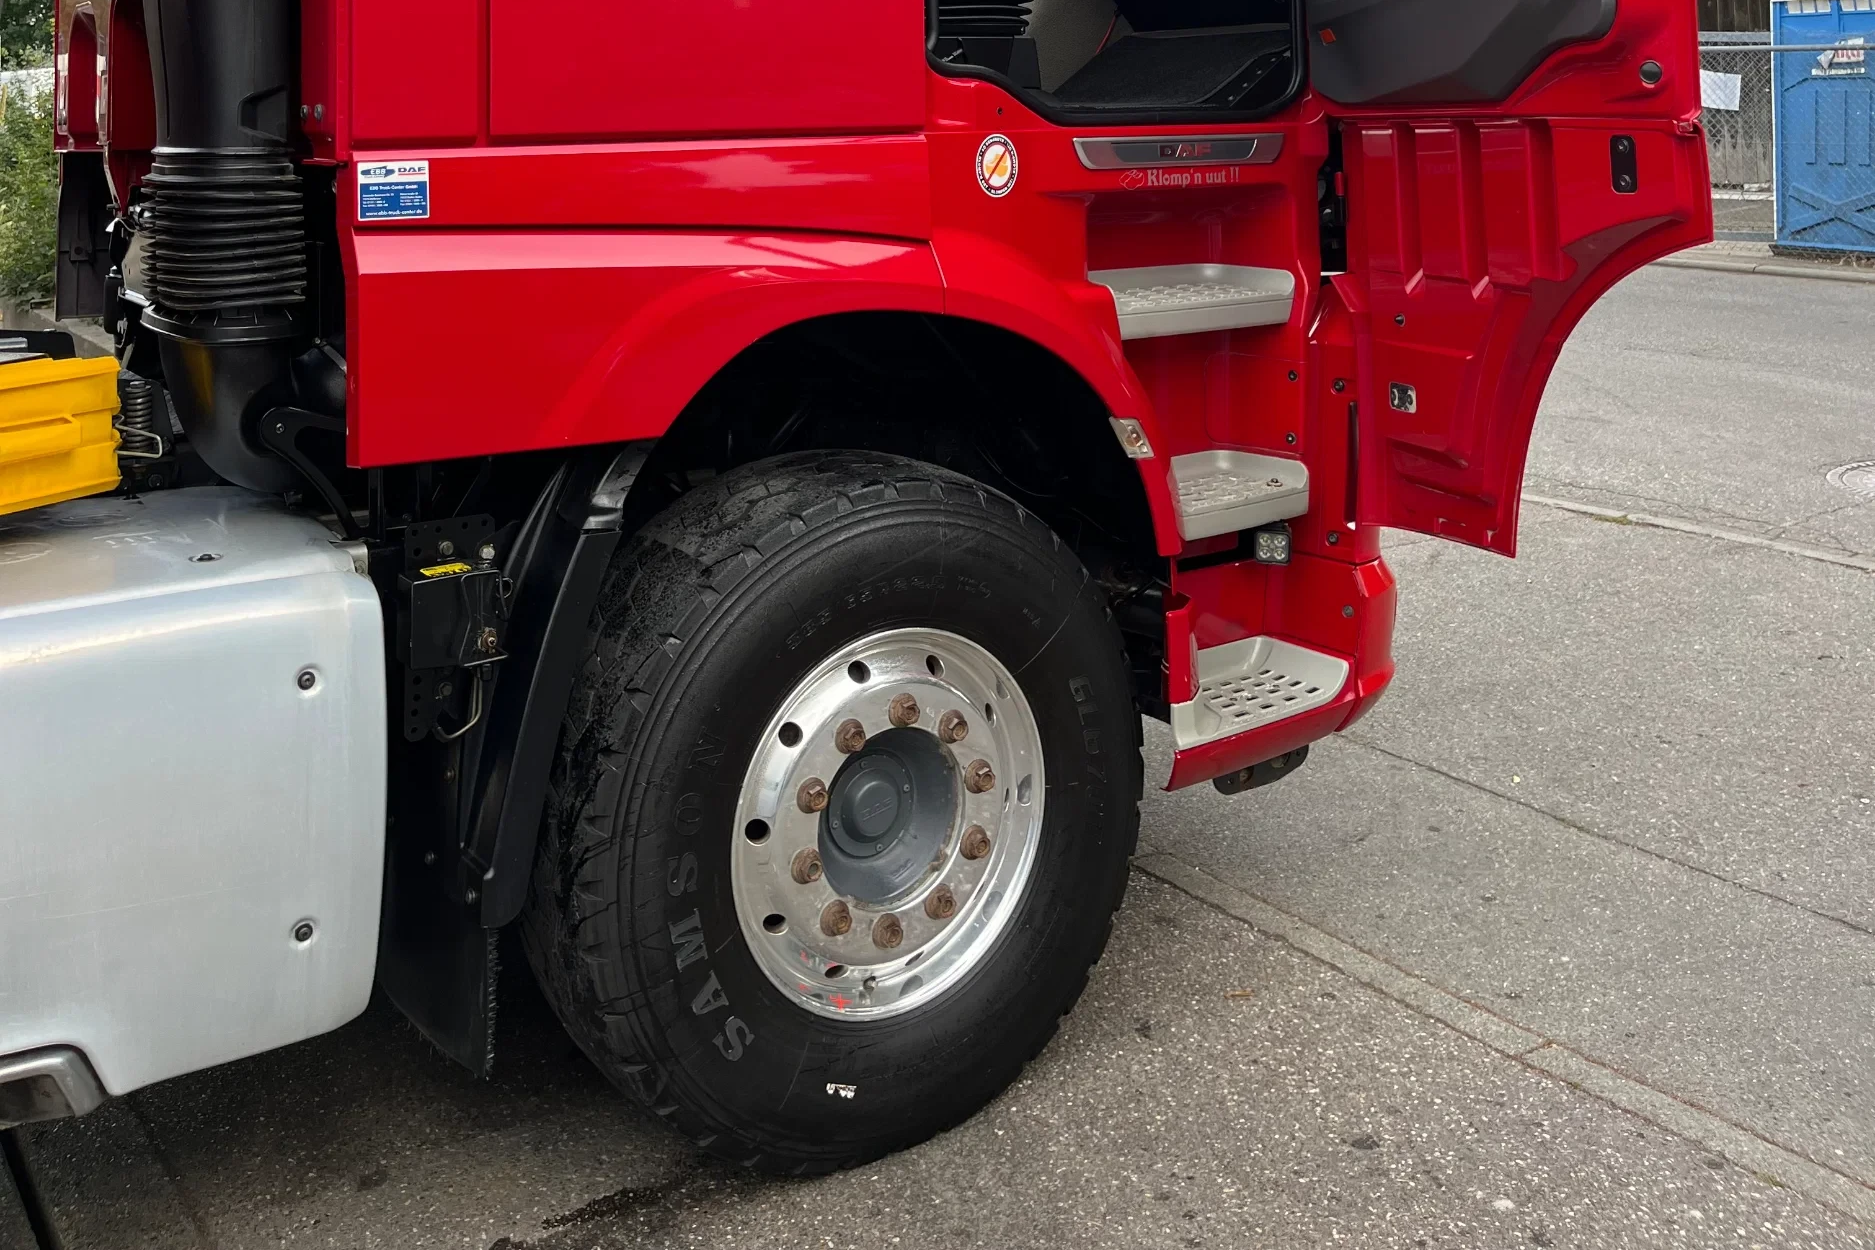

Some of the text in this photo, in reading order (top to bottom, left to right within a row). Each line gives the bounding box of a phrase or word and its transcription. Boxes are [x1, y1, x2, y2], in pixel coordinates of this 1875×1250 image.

[1158, 143, 1212, 157] DAF
[1205, 169, 1226, 183] uut
[666, 726, 755, 1062] SAMSON
